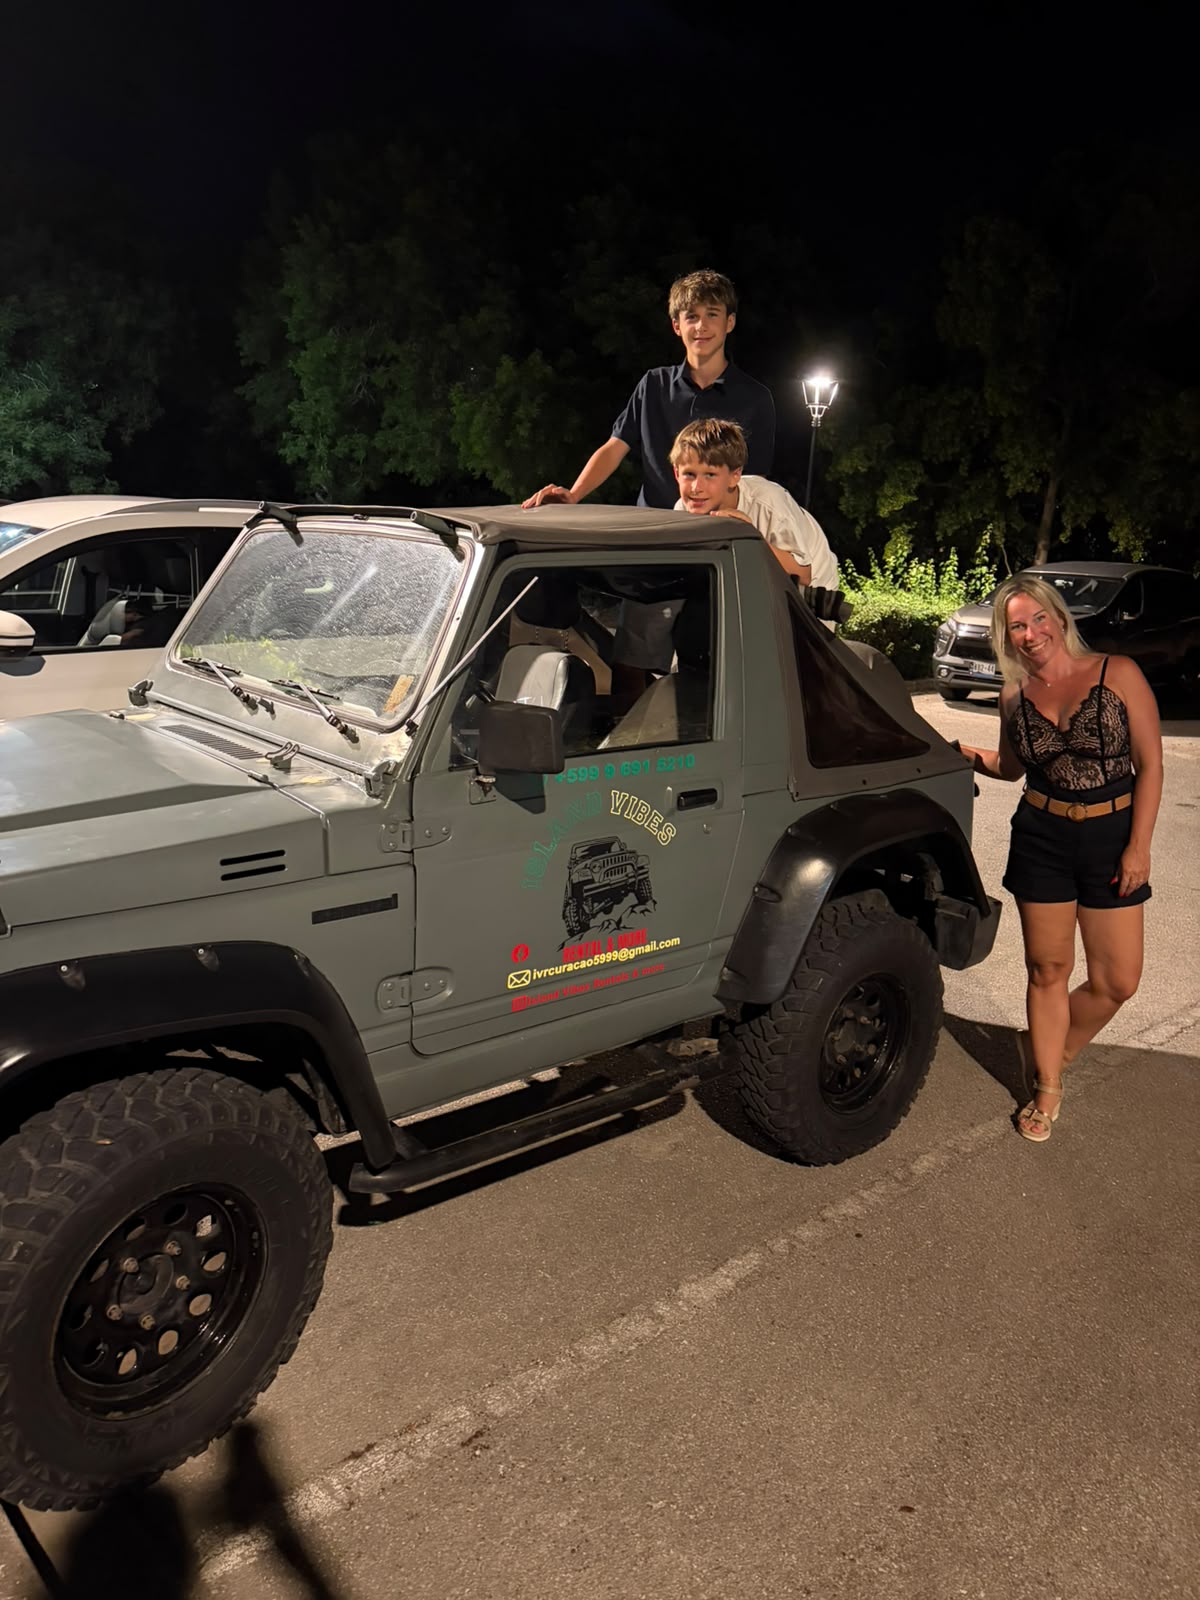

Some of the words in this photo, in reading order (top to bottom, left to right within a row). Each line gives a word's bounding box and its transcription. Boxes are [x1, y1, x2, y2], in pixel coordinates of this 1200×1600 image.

[555, 766, 600, 784] +599
[604, 763, 615, 779] 9
[620, 759, 650, 777] 691
[656, 754, 696, 773] 5210
[610, 790, 677, 846] VIBES
[562, 941, 602, 963] RENTAL
[606, 937, 615, 952] &
[618, 928, 648, 949] MORE
[527, 989, 560, 1006] Island
[562, 983, 590, 997] Vibes
[592, 971, 629, 988] Rentals
[641, 963, 665, 976] more
